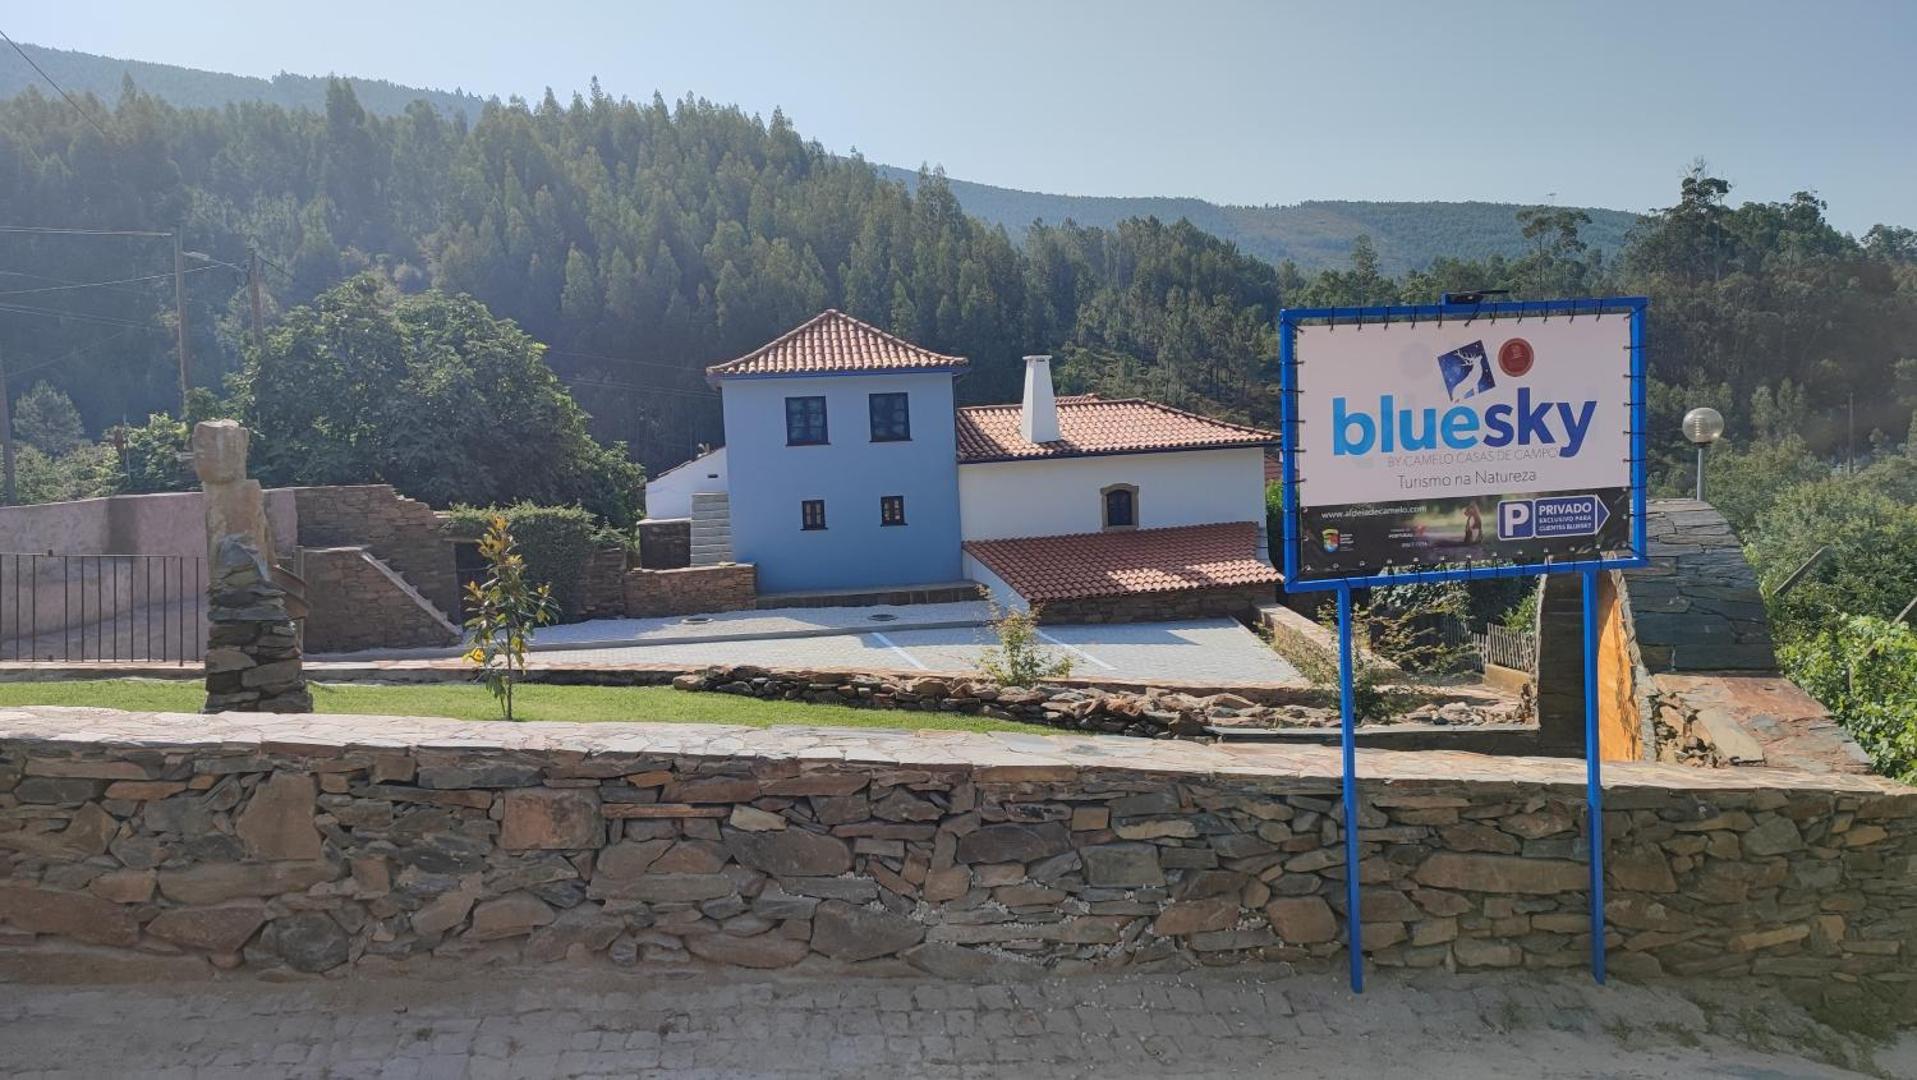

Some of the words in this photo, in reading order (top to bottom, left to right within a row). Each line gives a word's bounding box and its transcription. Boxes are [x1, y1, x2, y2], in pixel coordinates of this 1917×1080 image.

[1332, 387, 1597, 458] bluesky
[1388, 455, 1402, 467] BY
[1404, 453, 1454, 467] CAMELO
[1456, 450, 1494, 464] CASAS
[1497, 449, 1511, 462] DE
[1513, 447, 1559, 461] CAMPO
[1397, 474, 1451, 489] Turismo
[1455, 474, 1471, 486] na
[1475, 470, 1537, 484] Natureza
[1321, 505, 1427, 519] www.aldeiadecamelo.com
[1538, 502, 1592, 515] PRIVADO
[1504, 503, 1530, 536] P
[1539, 516, 1574, 524] EXCLUSIVO
